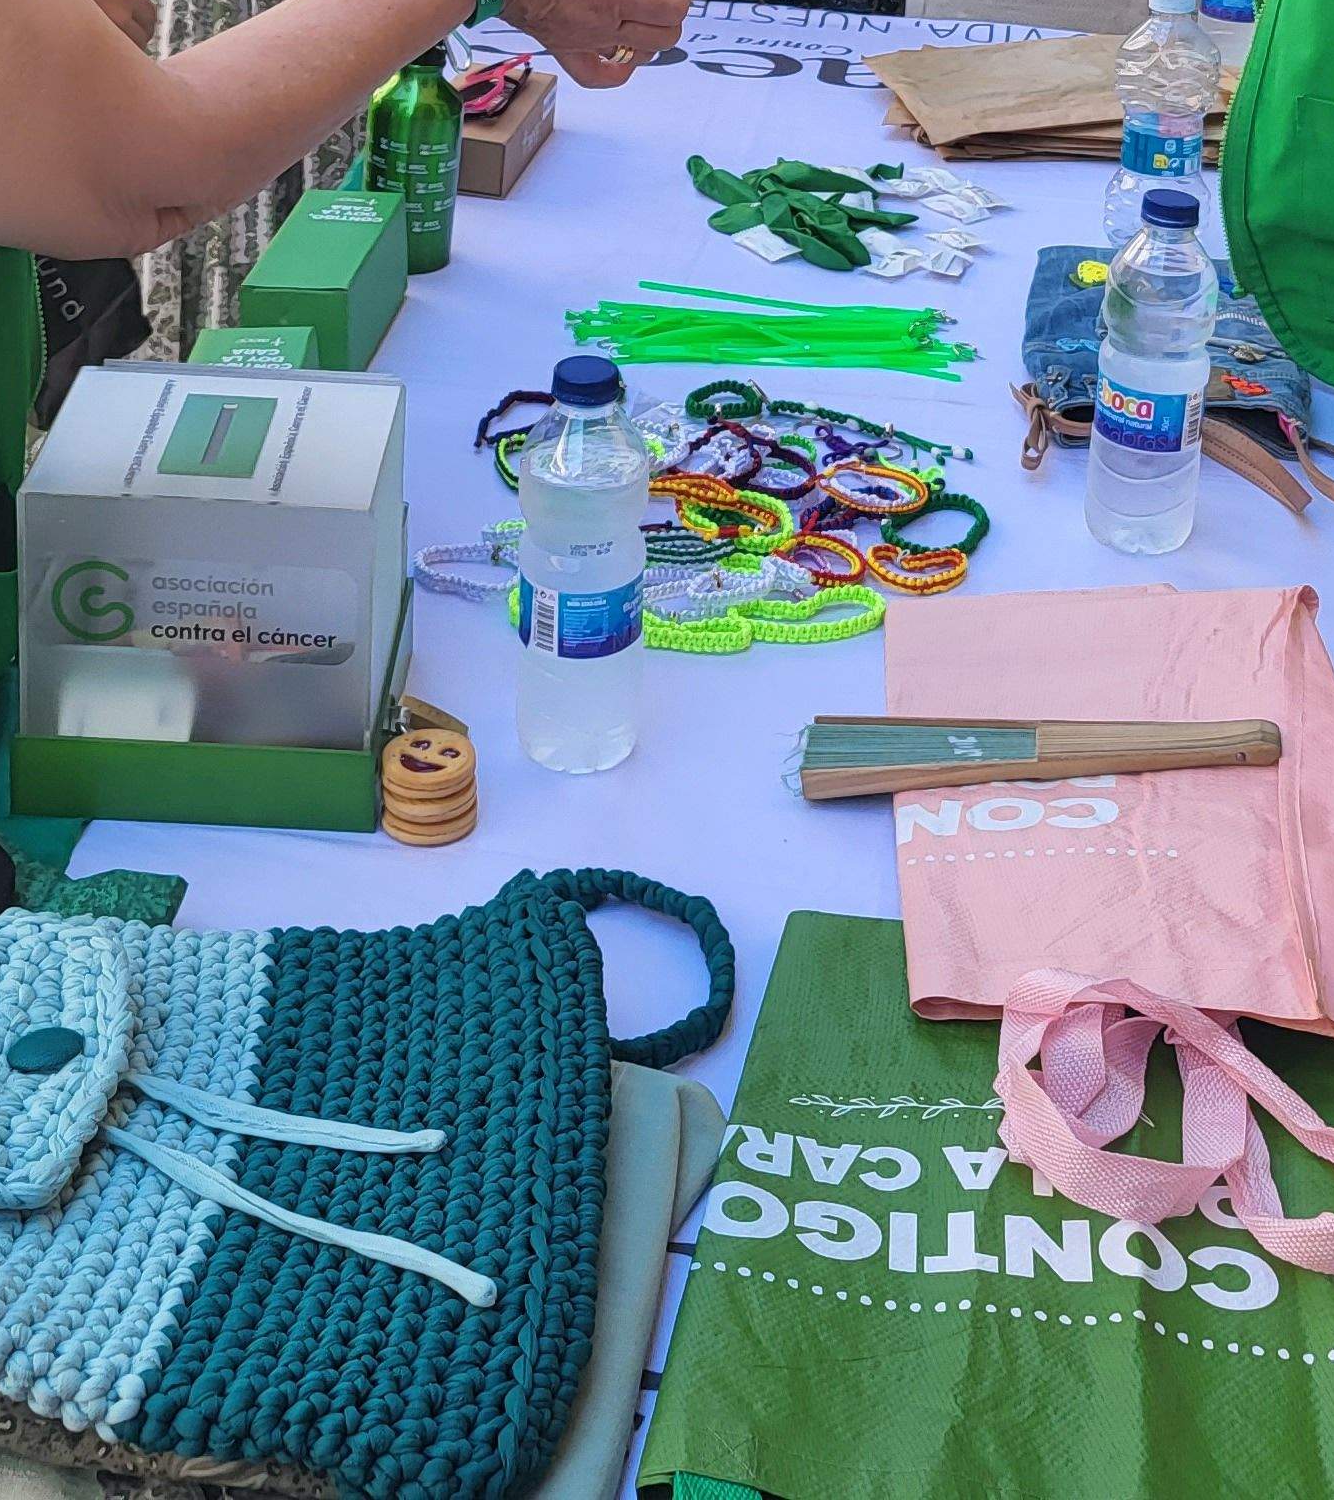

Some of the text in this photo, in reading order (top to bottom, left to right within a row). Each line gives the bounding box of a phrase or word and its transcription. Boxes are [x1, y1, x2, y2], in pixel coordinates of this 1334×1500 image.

[687, 32, 854, 56] Contra el
[151, 574, 275, 597] asociación
[151, 599, 258, 621] española
[150, 623, 338, 649] contra el cáncer
[725, 1124, 922, 1192] CAR
[701, 1180, 1280, 1312] CONTIGO
